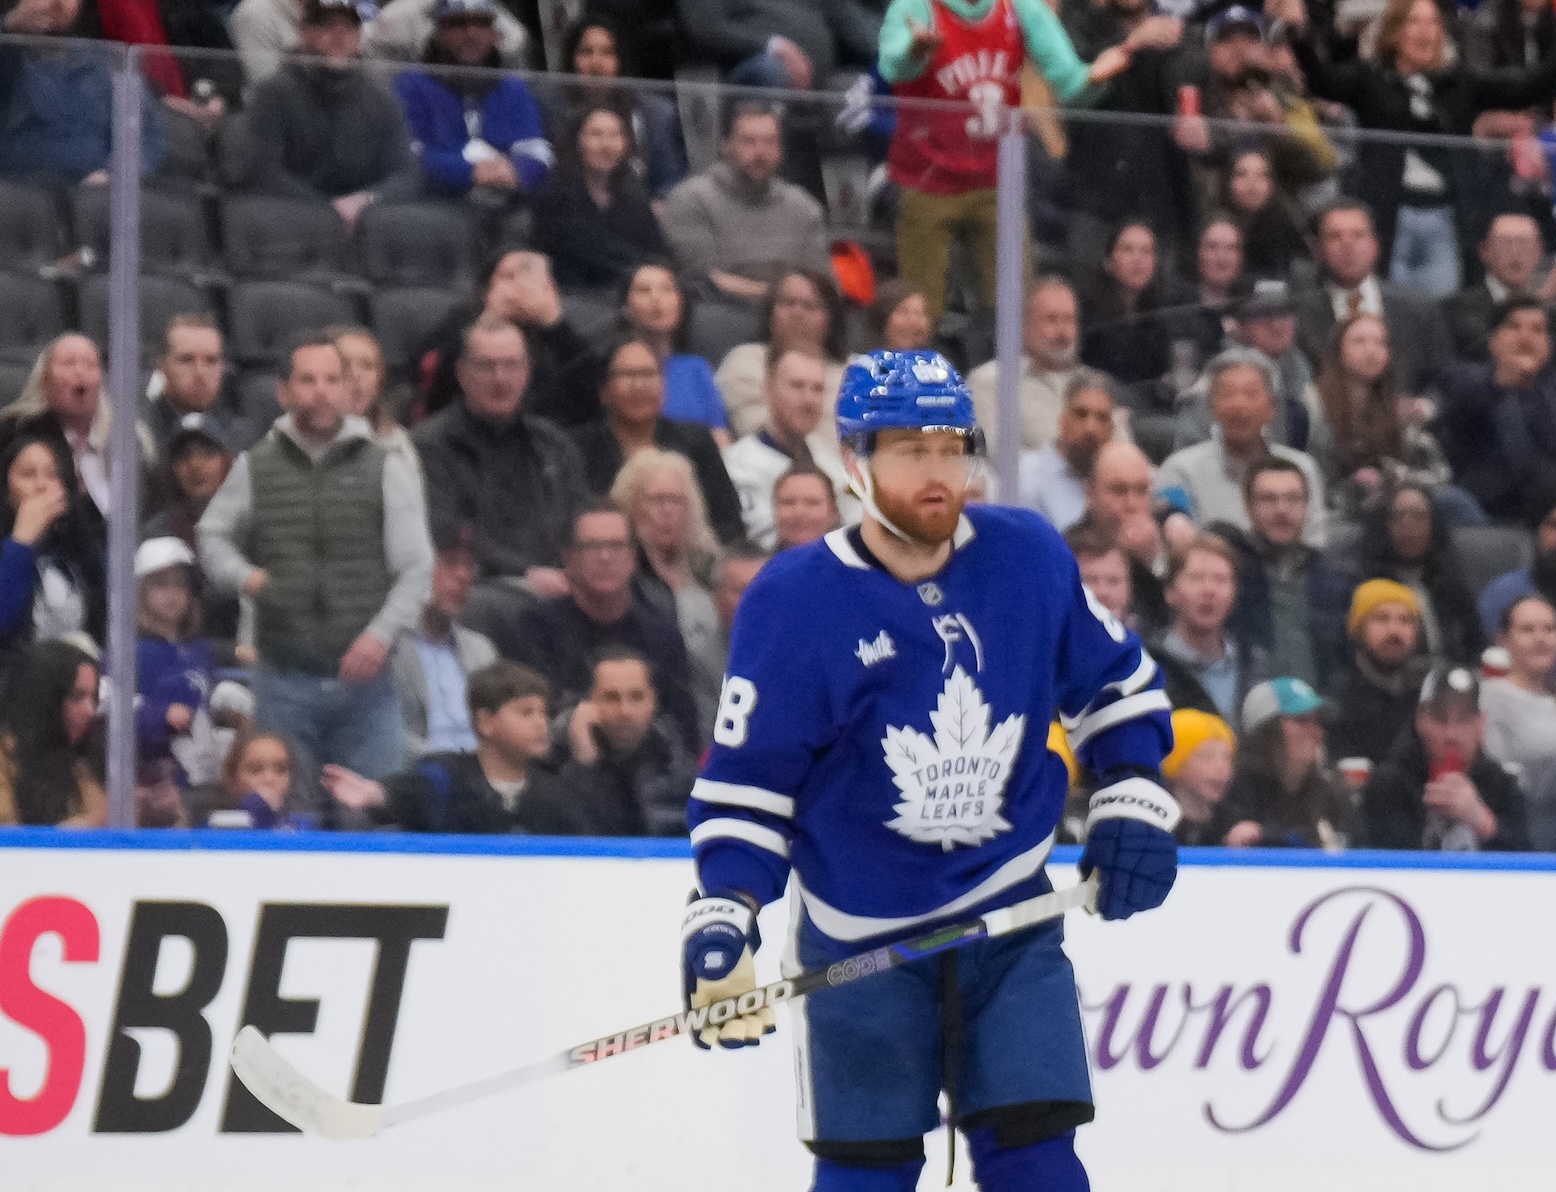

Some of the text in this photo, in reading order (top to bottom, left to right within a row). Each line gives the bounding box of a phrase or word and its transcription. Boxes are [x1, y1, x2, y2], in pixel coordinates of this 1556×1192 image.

[966, 80, 1004, 138] 3
[714, 674, 757, 749] 8
[911, 756, 1000, 787] TORONTO
[924, 779, 988, 801] MAPLE
[919, 800, 985, 820] LEAFS
[569, 980, 793, 1064] SHERWOOD
[1080, 982, 1278, 1073] wn
